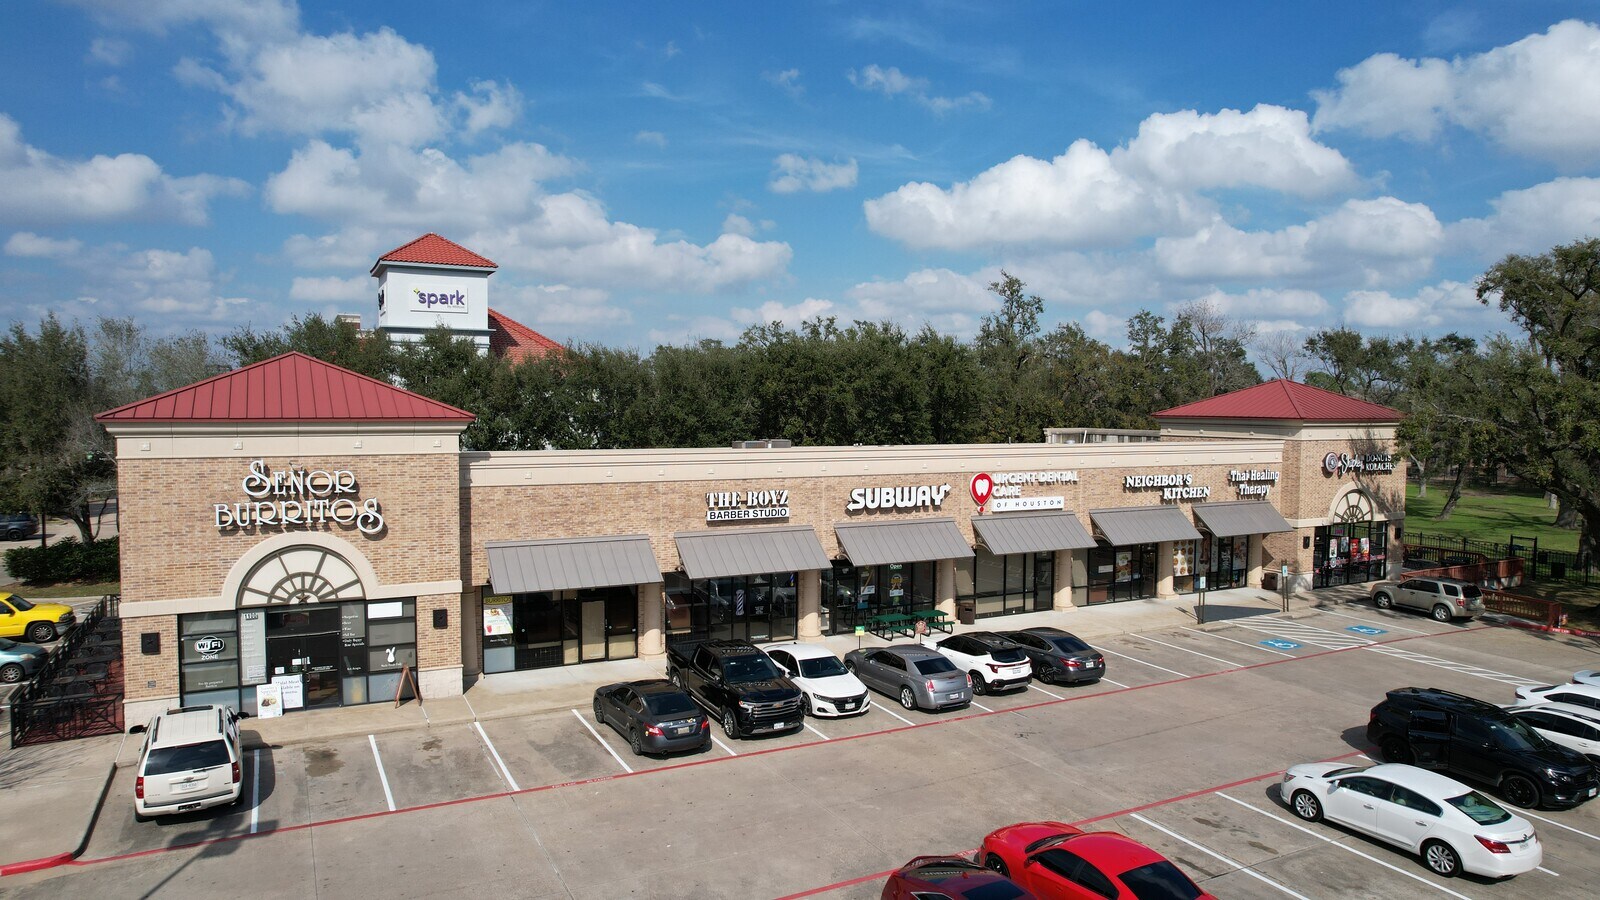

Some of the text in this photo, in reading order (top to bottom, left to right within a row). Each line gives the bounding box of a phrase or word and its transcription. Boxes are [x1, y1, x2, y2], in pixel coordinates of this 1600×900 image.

[418, 290, 465, 308] spark
[992, 470, 1080, 484] URGENT DENTAL
[1125, 473, 1193, 488] NEIGHBOR'S
[1230, 469, 1280, 482] Thai Healing
[846, 482, 952, 512] SUBWAY
[992, 485, 1022, 497] CARE
[1163, 486, 1211, 500] KITCHEN
[1239, 483, 1271, 497] Therapy
[706, 489, 789, 508] THE BOYZ
[1015, 499, 1062, 508] HOUSTON
[213, 497, 385, 535] BURRITOS
[709, 508, 787, 520] BARBER STUDIO
